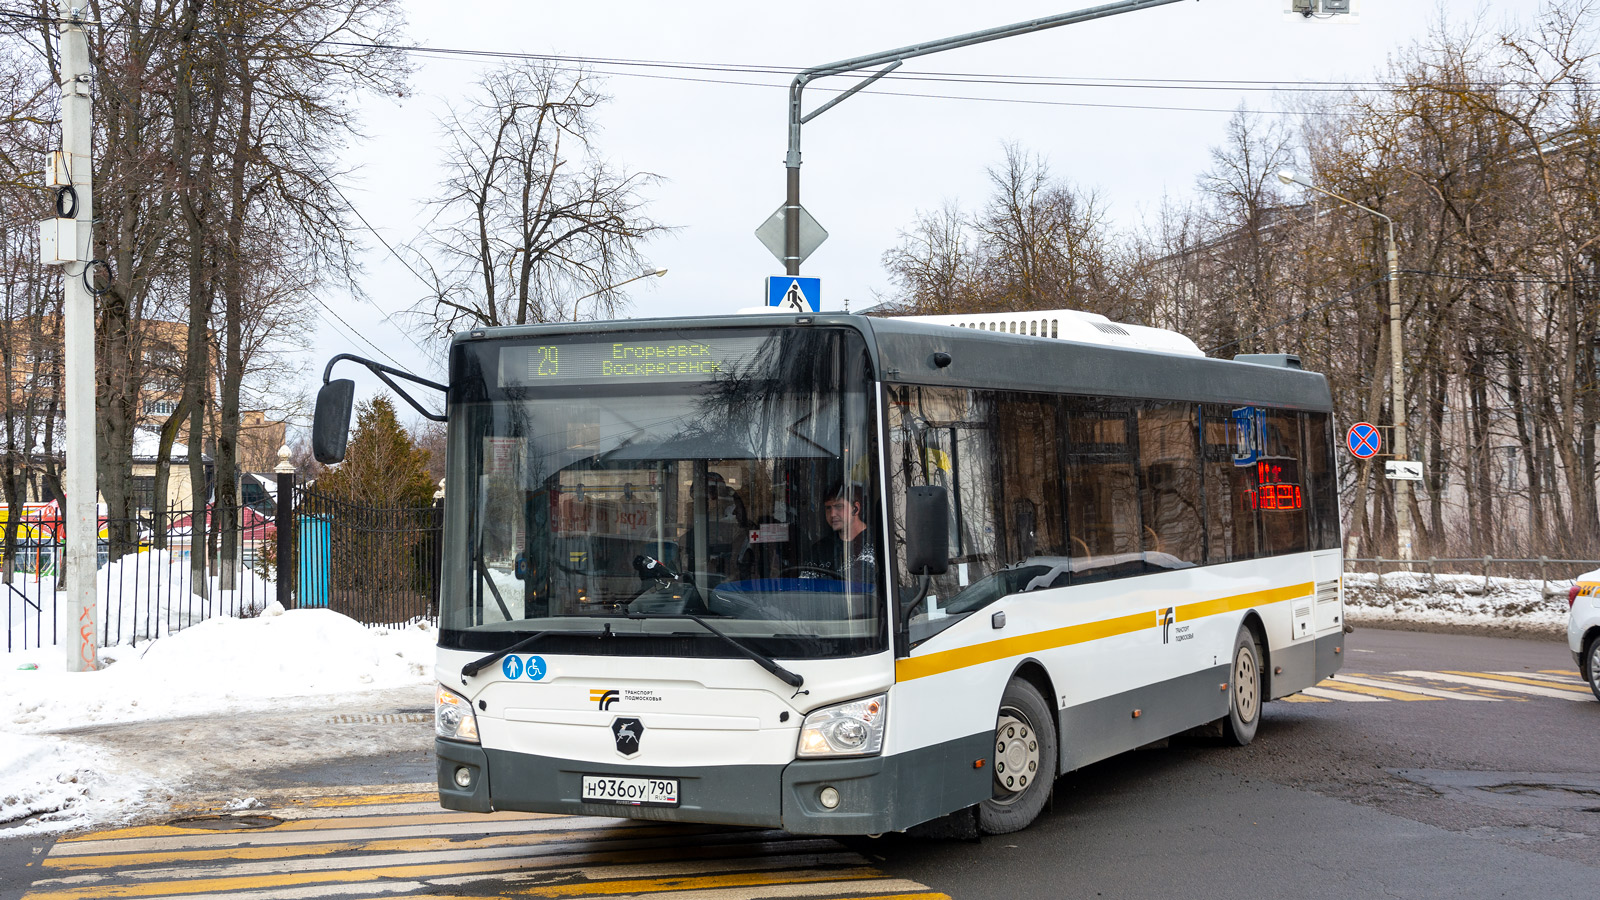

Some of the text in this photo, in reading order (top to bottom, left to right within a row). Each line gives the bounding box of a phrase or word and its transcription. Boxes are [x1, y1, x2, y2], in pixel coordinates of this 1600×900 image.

[612, 343, 711, 359] Егорьевск
[537, 346, 558, 376] 29
[602, 360, 723, 376] Воскресенск
[650, 781, 673, 795] 790
